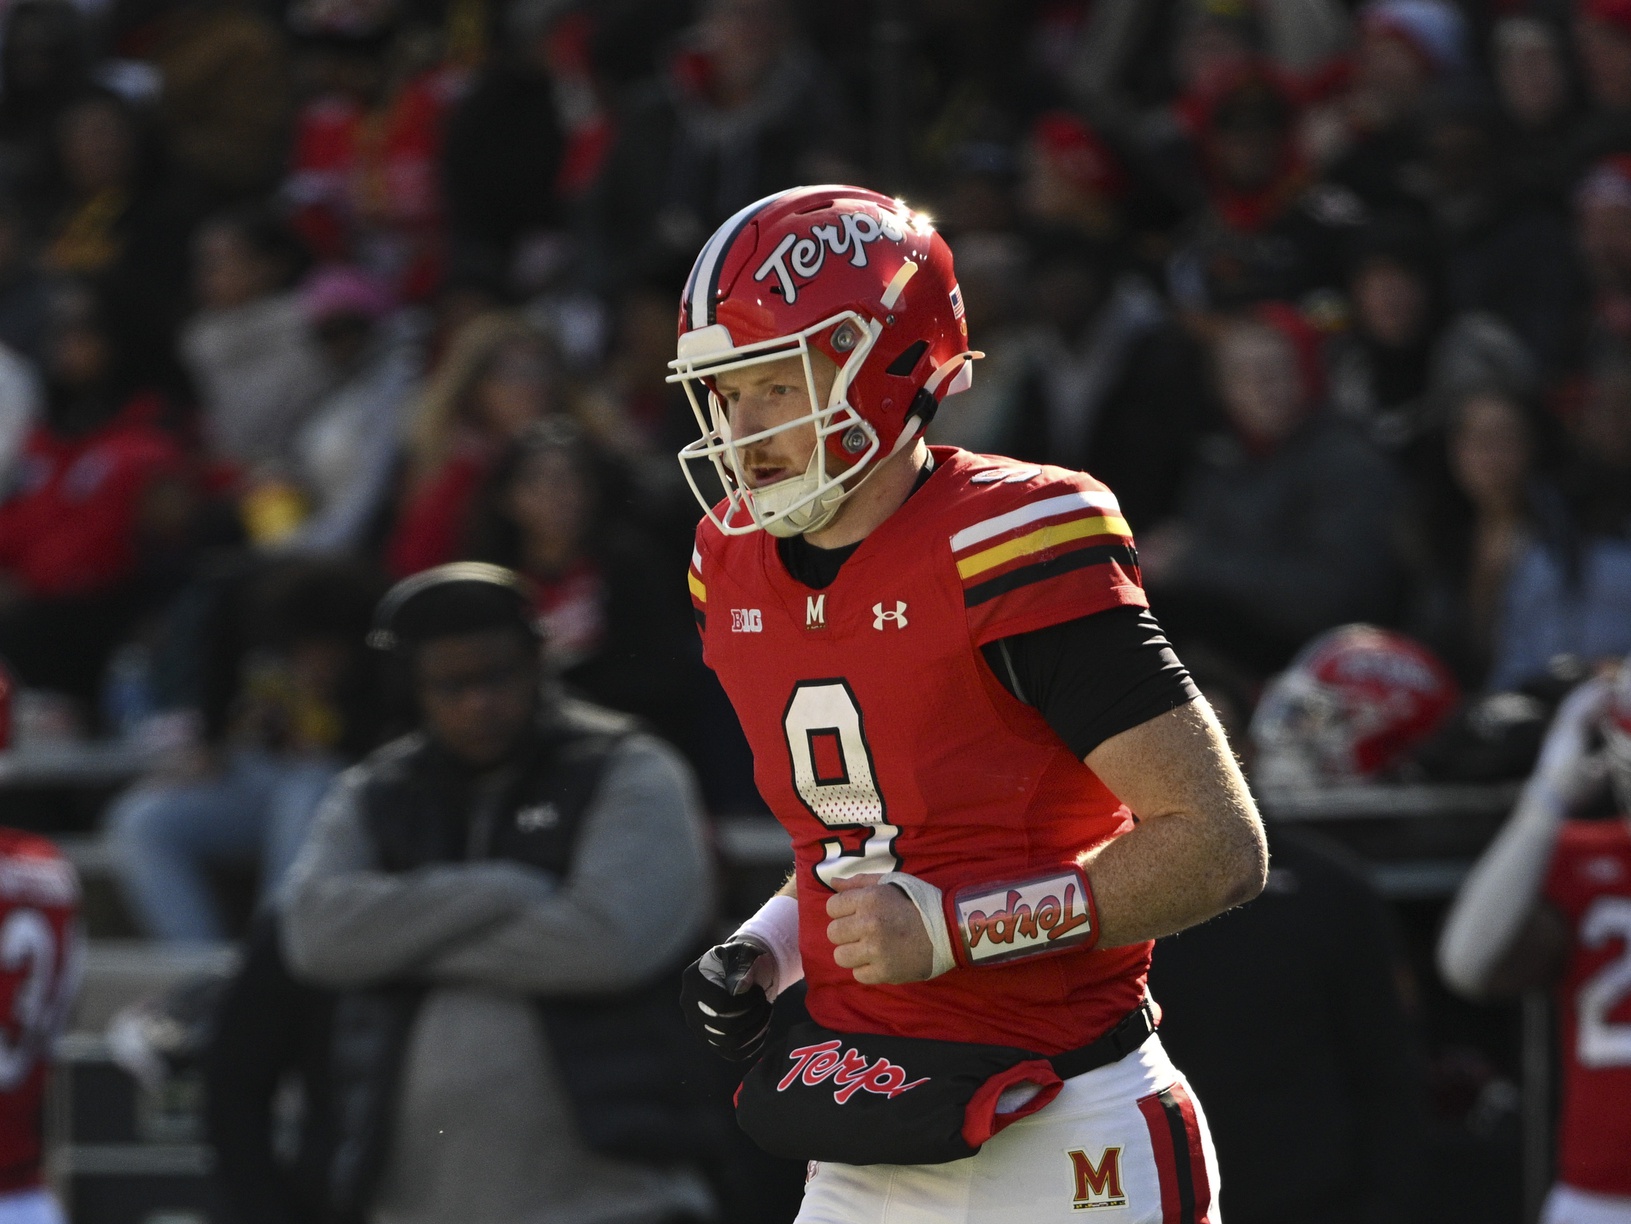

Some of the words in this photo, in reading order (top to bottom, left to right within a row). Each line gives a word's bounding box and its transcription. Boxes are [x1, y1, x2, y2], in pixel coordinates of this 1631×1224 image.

[805, 593, 826, 626] M
[781, 676, 904, 893] 9
[1068, 1147, 1125, 1202] M
